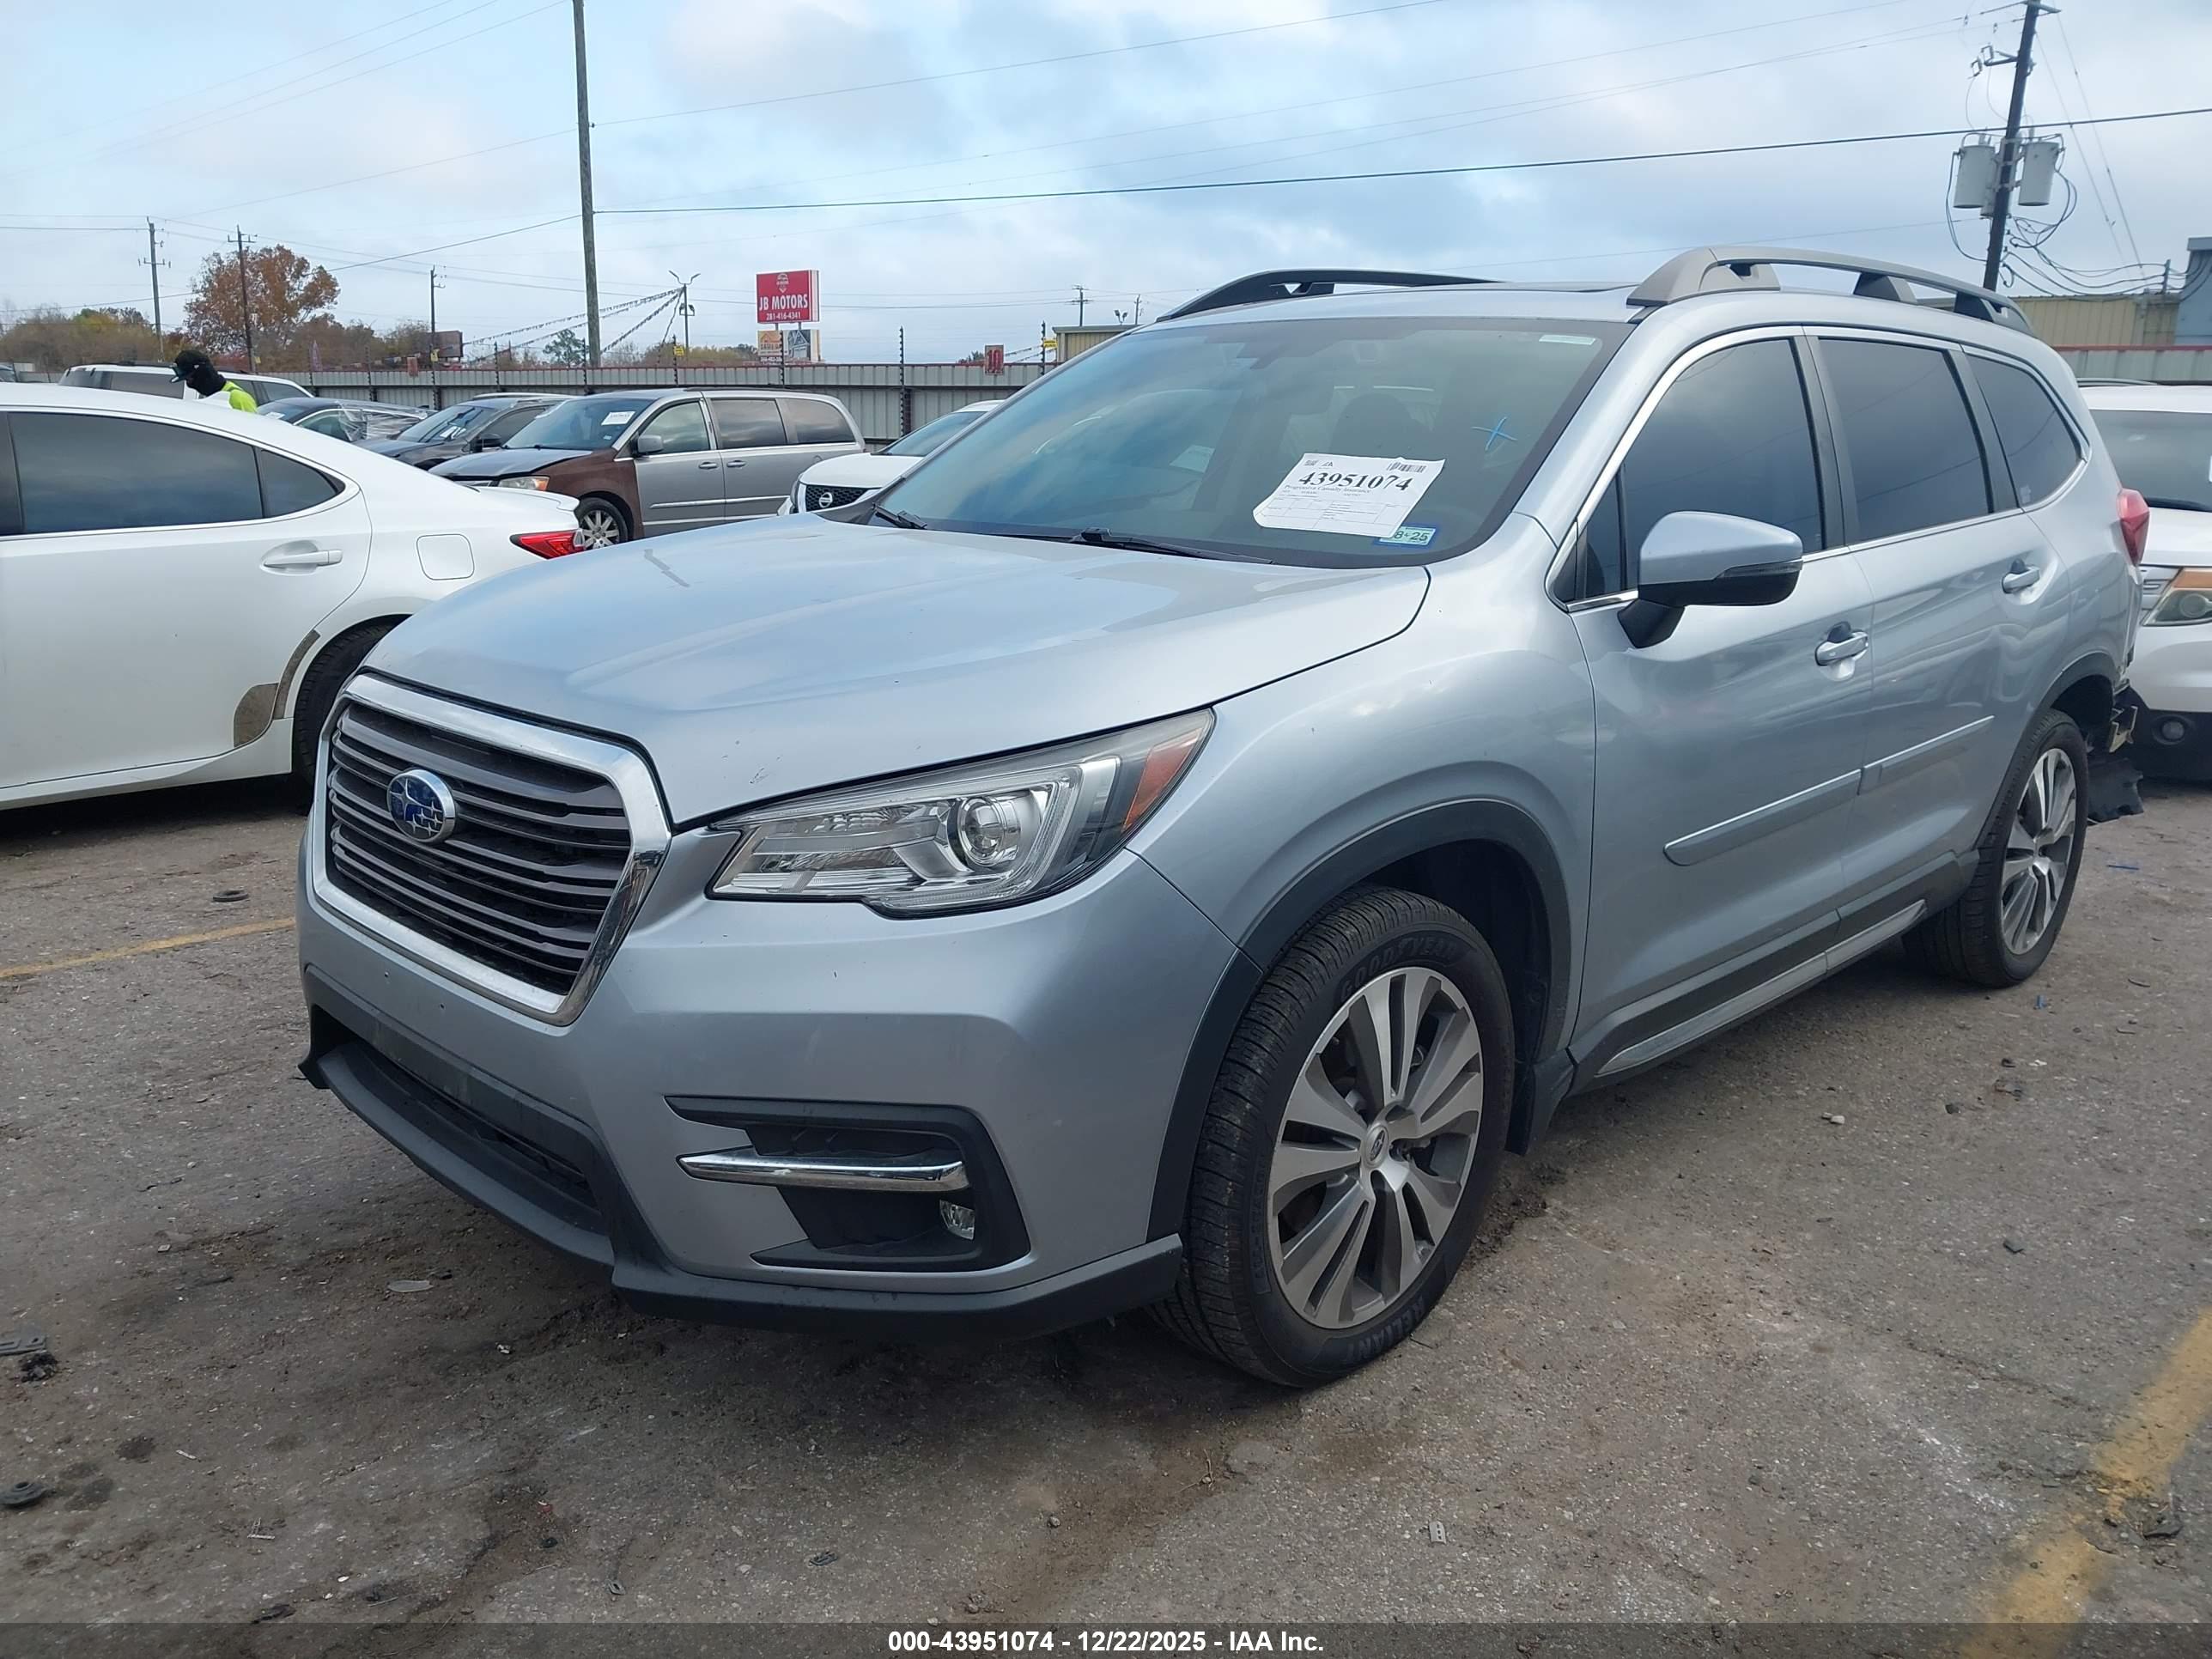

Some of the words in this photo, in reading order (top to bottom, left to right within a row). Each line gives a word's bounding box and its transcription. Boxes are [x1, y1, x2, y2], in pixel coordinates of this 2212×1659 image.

[759, 296, 769, 311] JB
[772, 294, 808, 310] MOTORS
[1298, 471, 1414, 491] 43951074
[1340, 937, 1457, 1004] GOODYEAR
[1346, 1295, 1425, 1362] RELIANT
